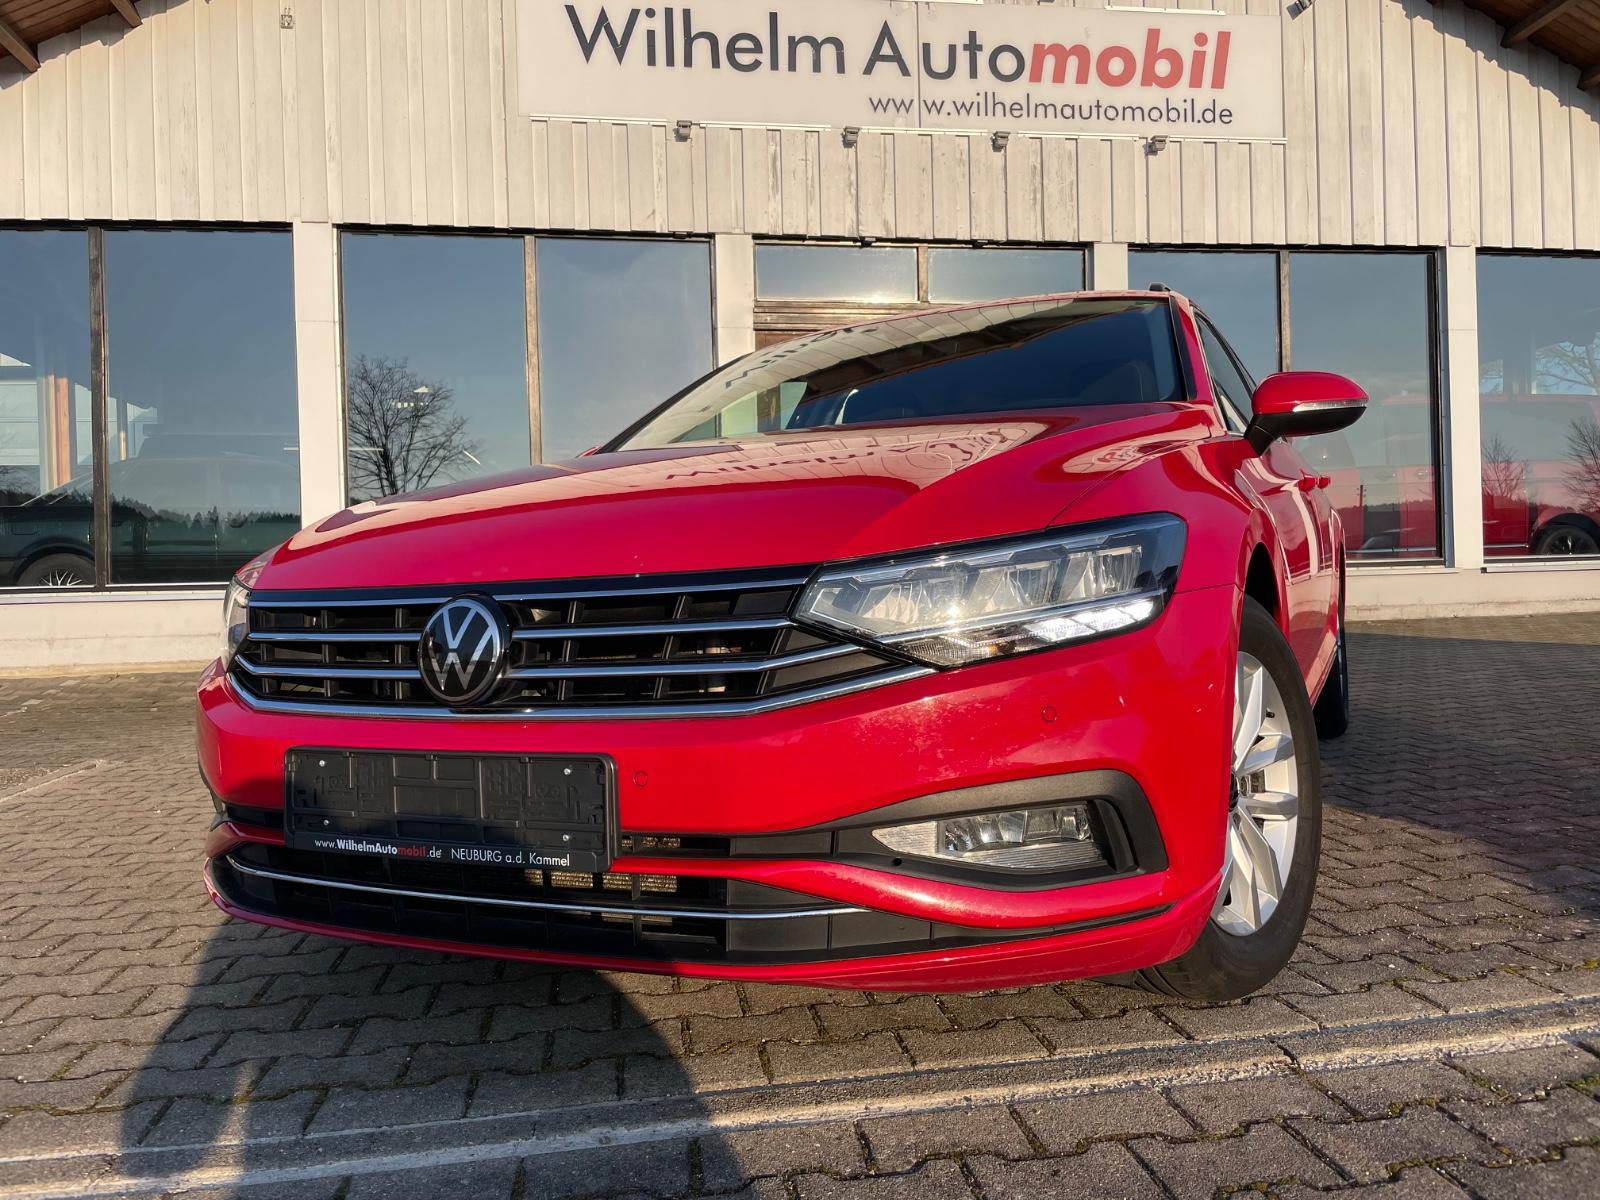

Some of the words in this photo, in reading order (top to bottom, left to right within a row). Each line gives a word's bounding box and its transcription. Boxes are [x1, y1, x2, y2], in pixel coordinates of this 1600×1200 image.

[564, 4, 846, 75] Wilhelm
[862, 19, 1232, 90] Automobil
[868, 92, 1234, 125] www.wilhelmautomobil.de
[420, 598, 501, 702] VW
[314, 838, 442, 859] www.WilhelmAutomobil.de
[451, 847, 502, 863] NEUBURG
[505, 851, 526, 864] a.d.
[528, 852, 570, 867] Kammel
